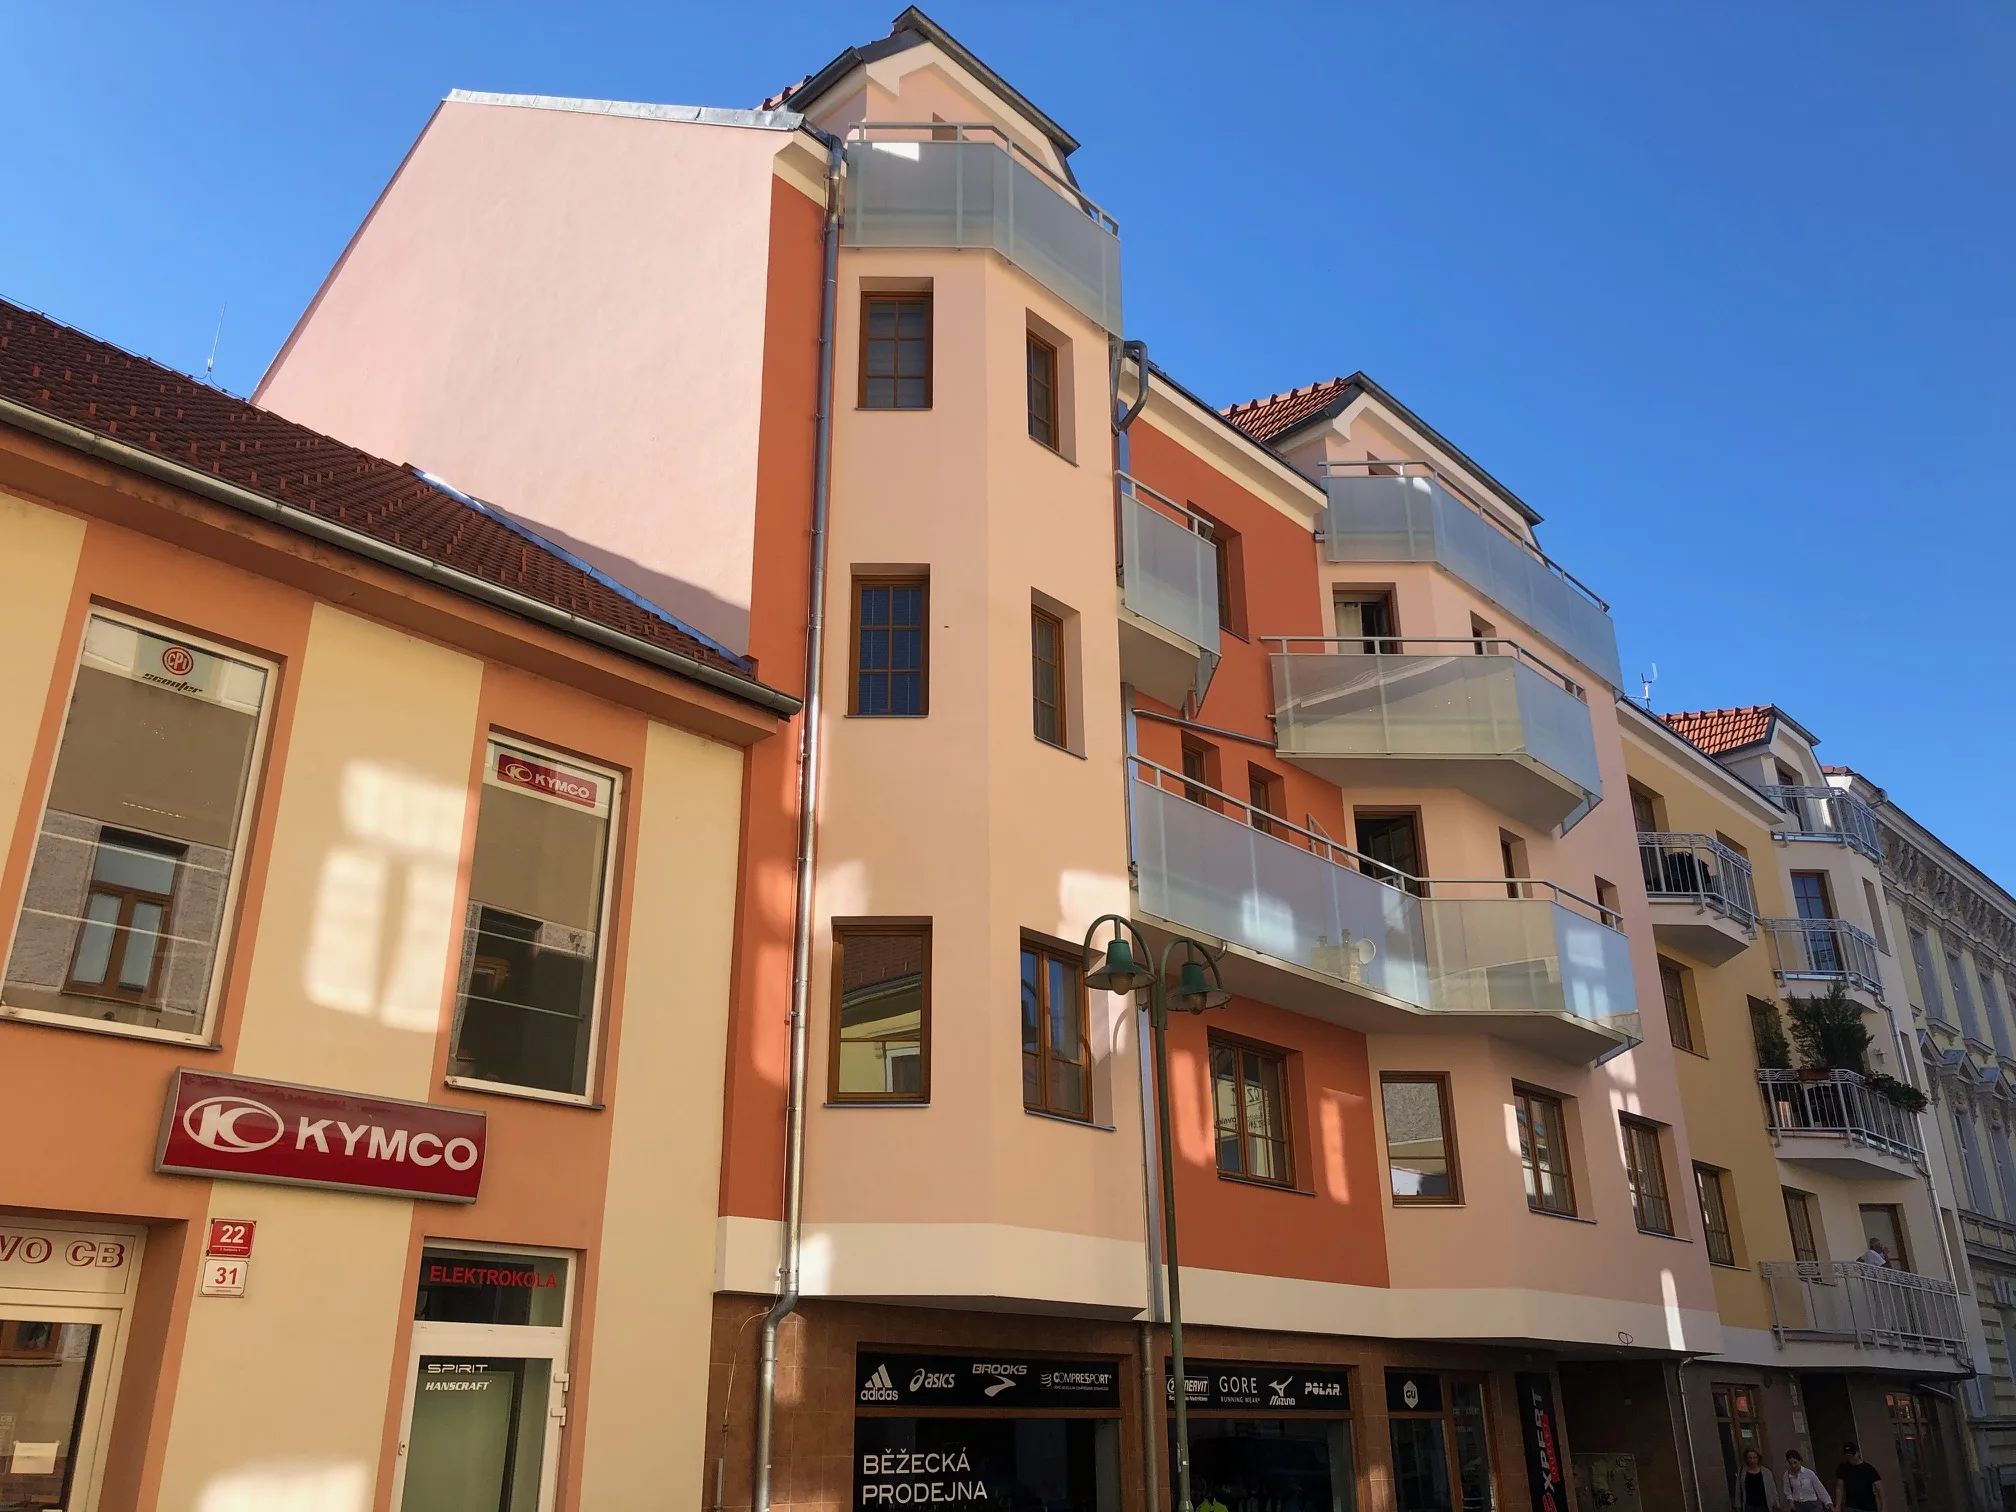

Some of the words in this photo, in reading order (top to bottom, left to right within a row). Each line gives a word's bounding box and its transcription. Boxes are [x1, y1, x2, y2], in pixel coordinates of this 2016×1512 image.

[168, 652, 188, 670] CPI
[535, 773, 590, 799] KYMCO
[295, 1116, 479, 1171] KYMCO
[220, 1224, 245, 1244] 22
[65, 1240, 125, 1268] CB
[215, 1266, 238, 1285] 31
[430, 1265, 557, 1288] ELEKTROKOLA
[427, 1363, 488, 1374] SPIRIT
[972, 1363, 1028, 1375] BROOKS
[425, 1381, 490, 1391] HANSCRAFT
[925, 1373, 956, 1388] asics
[1219, 1375, 1258, 1394] GORE
[1304, 1382, 1341, 1396] POLAR
[860, 1387, 899, 1401] adidas
[1405, 1389, 1416, 1399] GU
[863, 1447, 971, 1475] BĚŽECKÁ
[862, 1480, 988, 1505] PRODEJNA
